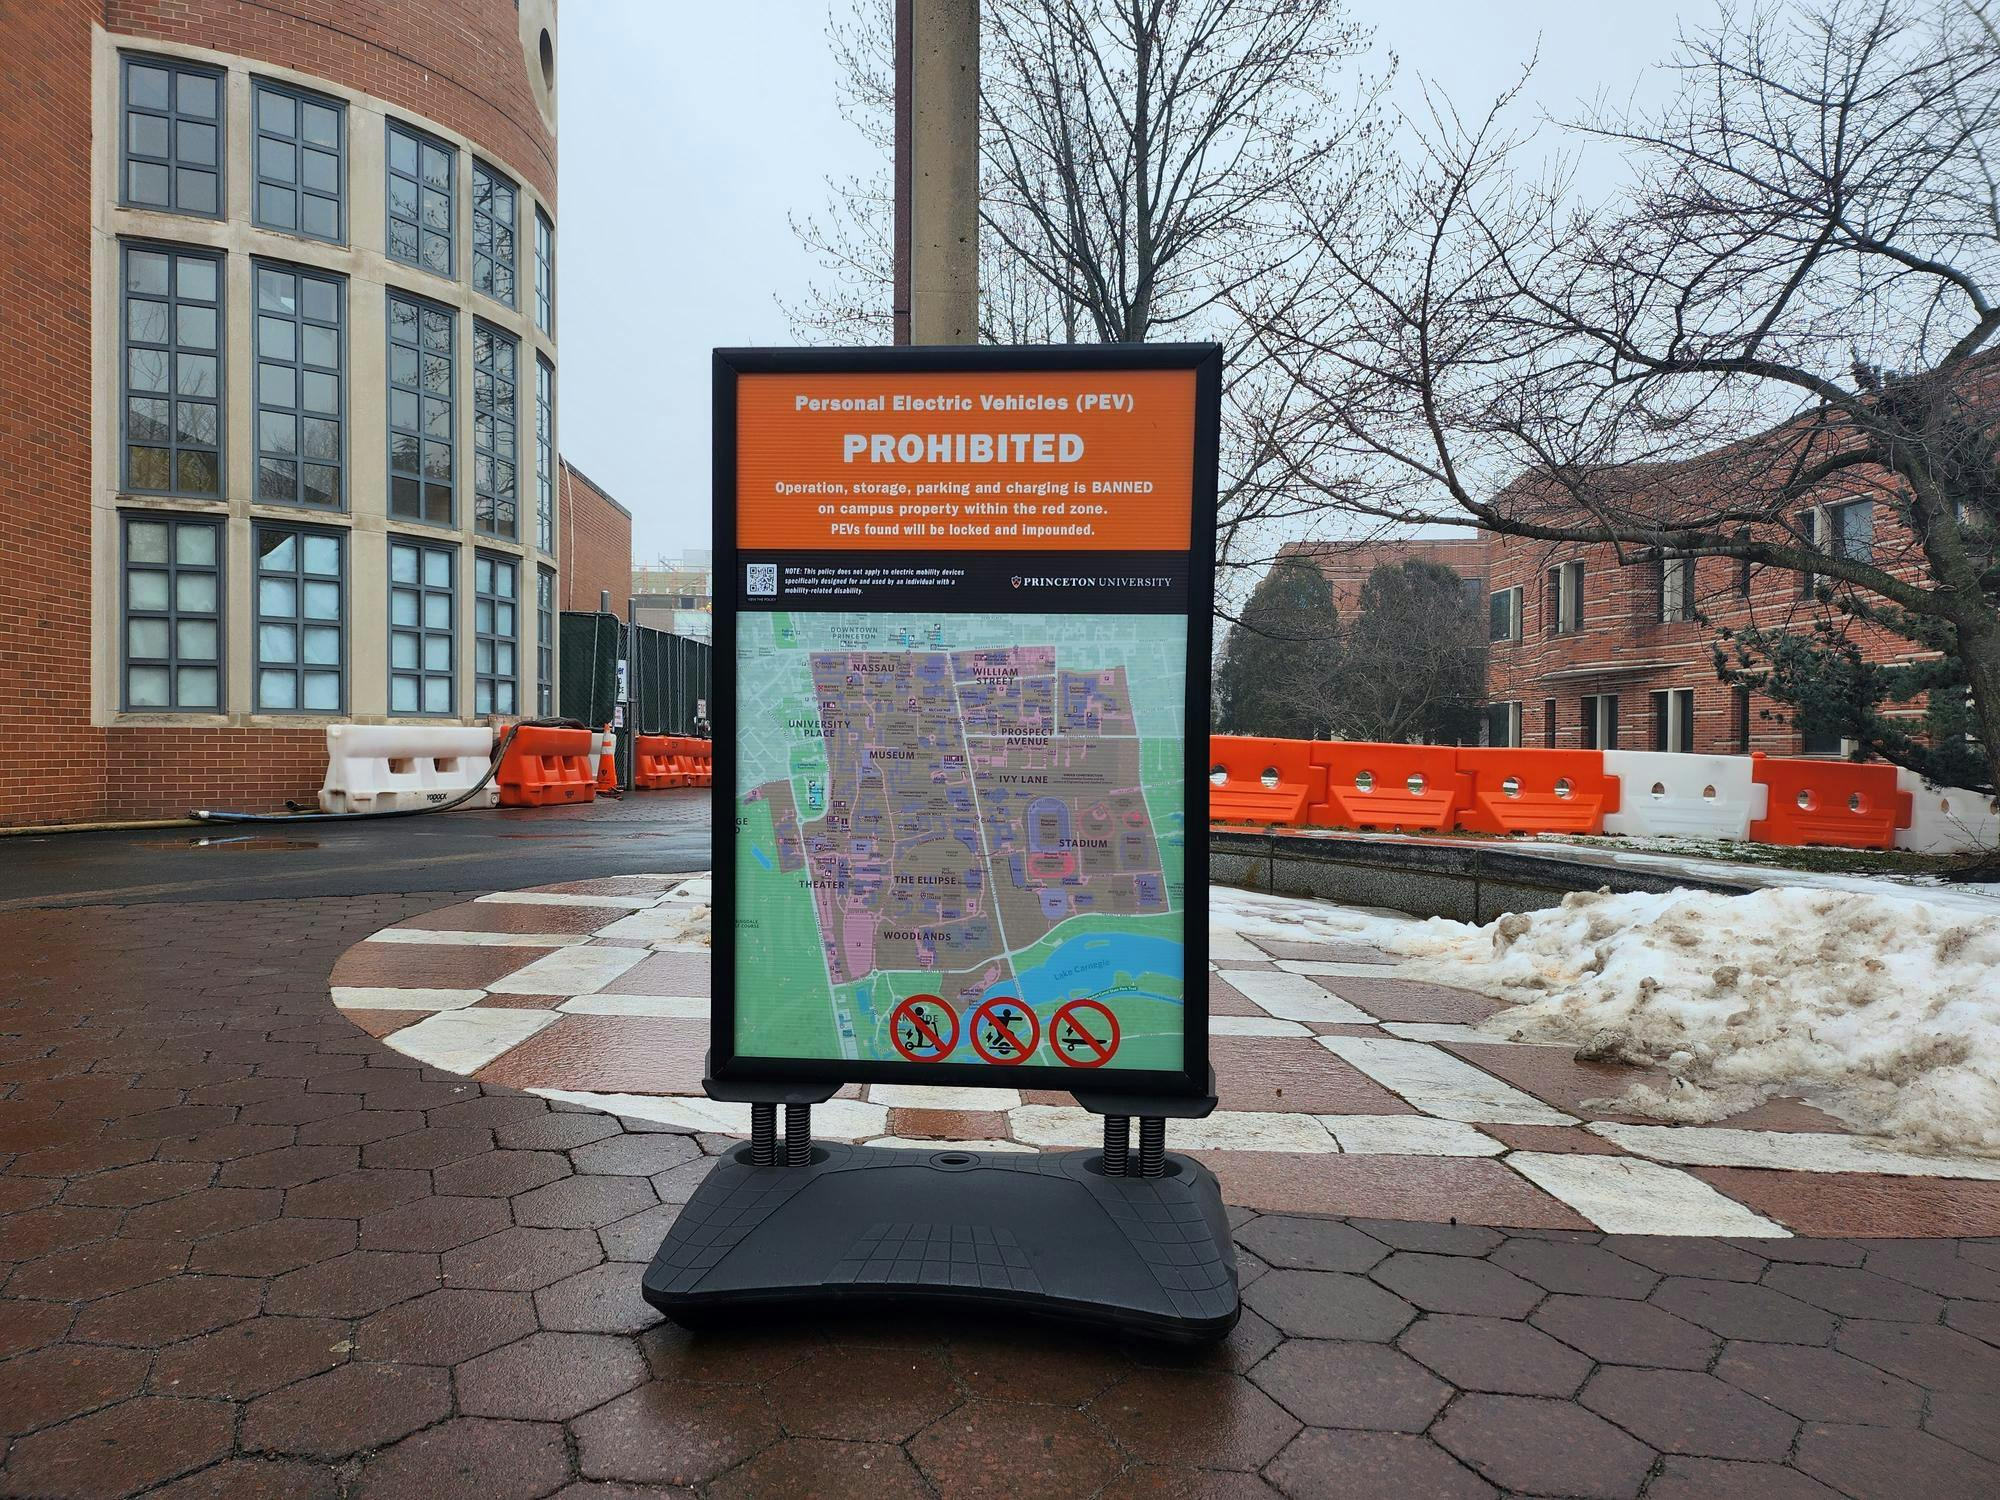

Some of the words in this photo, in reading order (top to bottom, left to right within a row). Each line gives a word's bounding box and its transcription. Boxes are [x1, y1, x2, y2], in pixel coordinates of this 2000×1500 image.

[795, 395, 885, 411] Personal
[892, 394, 973, 411] Electric
[979, 394, 1069, 411] Vehicles
[1075, 393, 1134, 412] (PEV)
[843, 433, 1085, 464] PROHIBITED
[775, 481, 848, 496] Operation,
[852, 482, 911, 497] storage,
[916, 481, 971, 497] parking
[975, 481, 1001, 494] and
[1005, 481, 1069, 497] charging
[1073, 481, 1087, 494] is
[1092, 481, 1154, 494] BANNED
[818, 504, 835, 514] on
[839, 504, 894, 517] campus
[899, 502, 959, 517] property
[964, 502, 1008, 515] within
[1013, 502, 1037, 515] the
[1042, 502, 1065, 515] red
[1069, 504, 1108, 515] zone.
[831, 523, 861, 535] PEVs
[864, 523, 900, 535] found
[903, 523, 925, 536] will
[929, 523, 945, 536] be
[949, 523, 990, 536] locked
[994, 523, 1018, 536] and
[1022, 523, 1095, 538] impounded.
[784, 567, 803, 575] NOTE:
[804, 567, 816, 575] This
[817, 567, 836, 577] policy
[852, 568, 863, 576] not
[864, 568, 881, 577] apply
[882, 568, 890, 576] to
[890, 568, 915, 576] electric
[915, 568, 941, 577] mobility
[941, 568, 966, 576] devices
[784, 577, 819, 586] specifically
[820, 577, 848, 586] designed
[848, 577, 858, 585] for
[859, 577, 871, 585] and
[871, 577, 887, 585] used
[887, 577, 895, 586] by
[904, 577, 936, 586] individual
[1023, 577, 1096, 587] PRINCETON
[1098, 577, 1172, 587] UNIVERSITY
[784, 587, 833, 595] mobility-related
[833, 587, 864, 596] disability.
[853, 664, 895, 672] NASSAU
[973, 667, 1019, 676] WILLIAM
[976, 677, 1014, 685] STREET
[788, 720, 851, 729] UNIVERSITY
[803, 729, 836, 738] PLACE
[1001, 728, 1055, 736] PROSPECT
[1006, 737, 1049, 745] AVENUE
[869, 751, 915, 759] MUSEUM
[999, 775, 1018, 784] IVY
[1021, 775, 1049, 784] LANE
[1059, 839, 1108, 848] STADIUM
[799, 880, 845, 889] THEATER
[894, 875, 914, 884] THE
[917, 876, 957, 885] ELLIPSE
[883, 932, 952, 941] WOODLANDS
[1053, 969, 1073, 981] Lake
[1074, 959, 1110, 973] Carnegie
